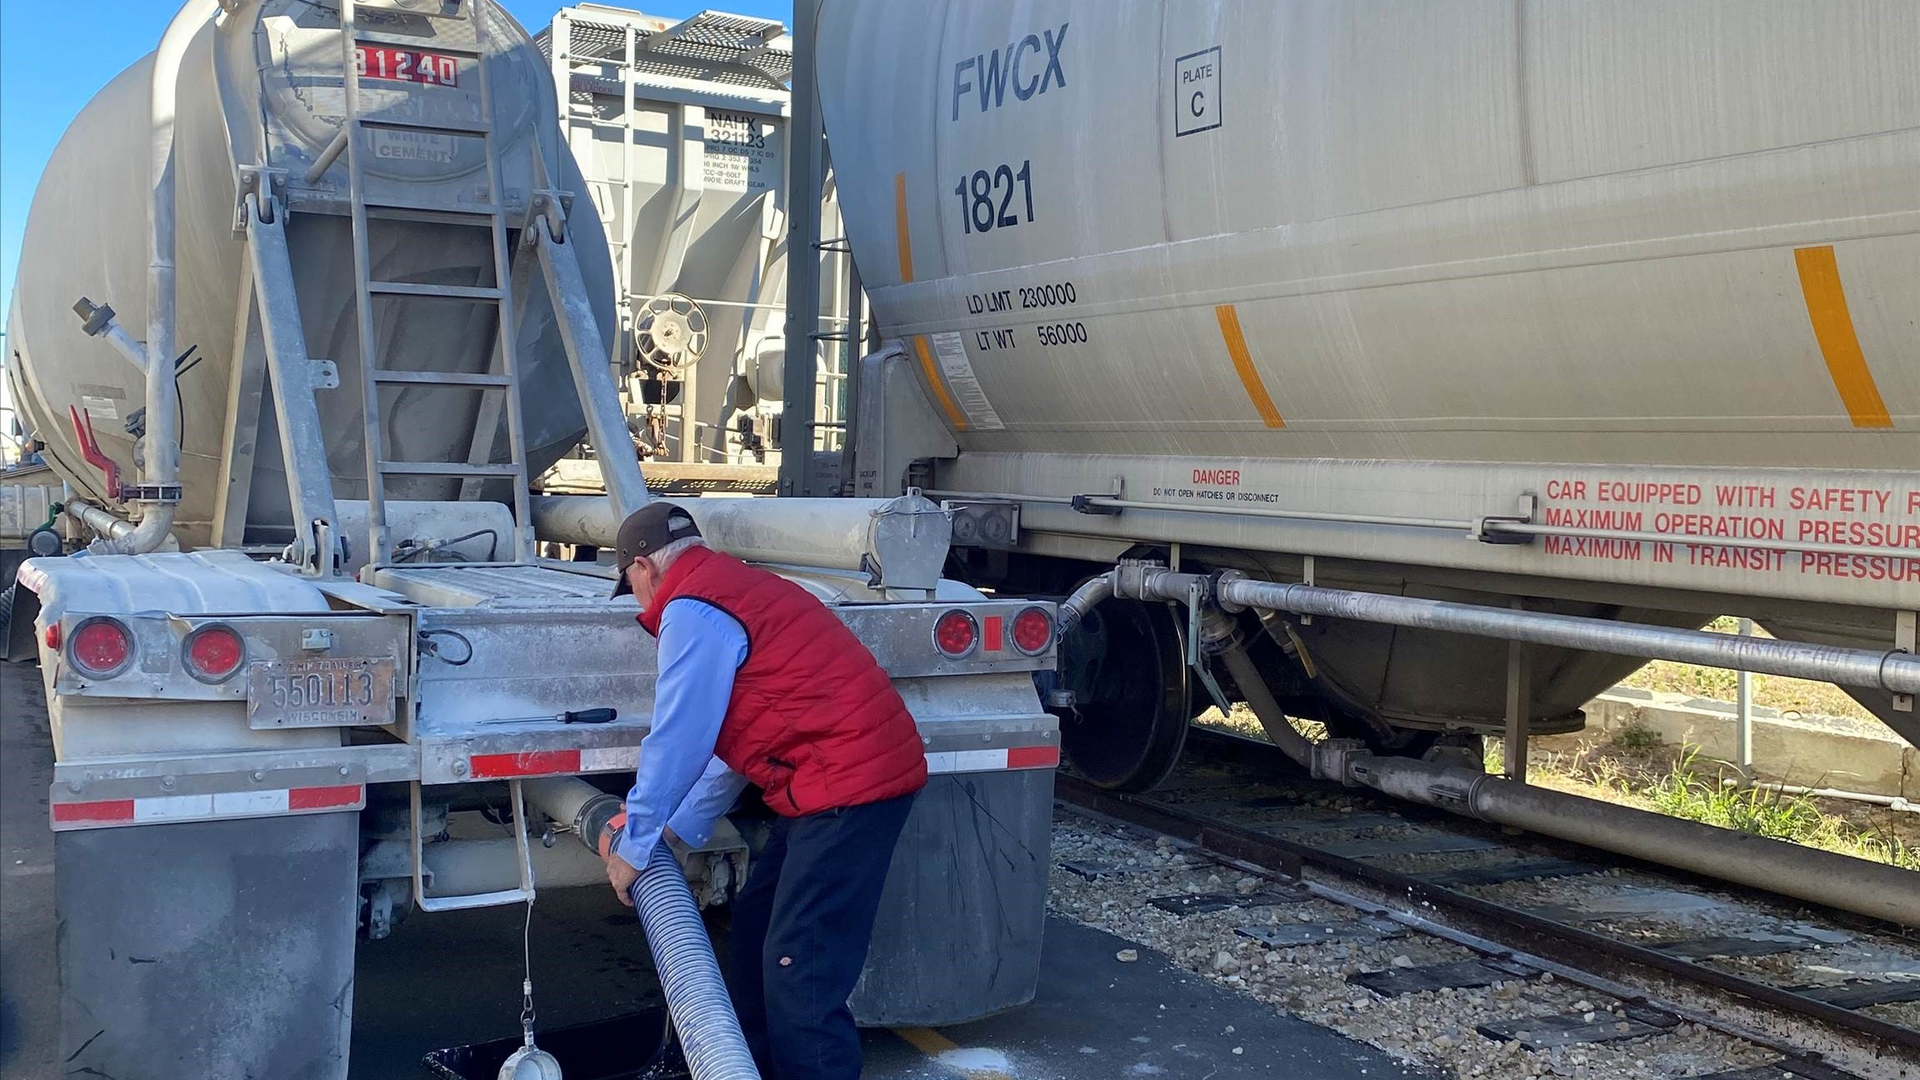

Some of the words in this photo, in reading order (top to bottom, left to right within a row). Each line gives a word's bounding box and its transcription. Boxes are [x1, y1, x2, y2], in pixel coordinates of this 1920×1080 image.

[952, 22, 1069, 121] FWCX
[1183, 63, 1212, 84] PLATE
[1191, 91, 1205, 117] C
[710, 113, 756, 131] NAHX
[387, 130, 440, 144] WHITE
[711, 129, 765, 149] 321123
[380, 145, 450, 162] CEMENT
[954, 160, 1034, 234] 1821
[966, 294, 983, 314] LD
[985, 290, 1012, 312] LMT
[1019, 282, 1076, 309] 230000
[975, 331, 990, 350] LT
[992, 329, 1016, 349] WT
[1037, 322, 1087, 346] 56000
[1193, 469, 1240, 485] DANGER
[1153, 488, 1161, 496] DO
[1164, 488, 1175, 497] NOT
[1178, 489, 1194, 498] OPEN
[1197, 490, 1223, 500] HATCHES
[1226, 492, 1235, 500] OR
[1238, 492, 1279, 503] DISCONNECT
[1547, 480, 1586, 500] CAR
[1598, 481, 1701, 505] EQUIPPED
[1716, 485, 1775, 508] WITH
[1789, 487, 1892, 513] SAFETY
[1546, 508, 1642, 532] MAXIMUM
[1655, 513, 1784, 540] OPERATION
[1544, 535, 1640, 561] MAXIMUM
[1653, 542, 1673, 563] IN
[1687, 543, 1786, 572] TRANSIT
[268, 672, 373, 708] 550113
[287, 710, 359, 723] WISCONSIN
